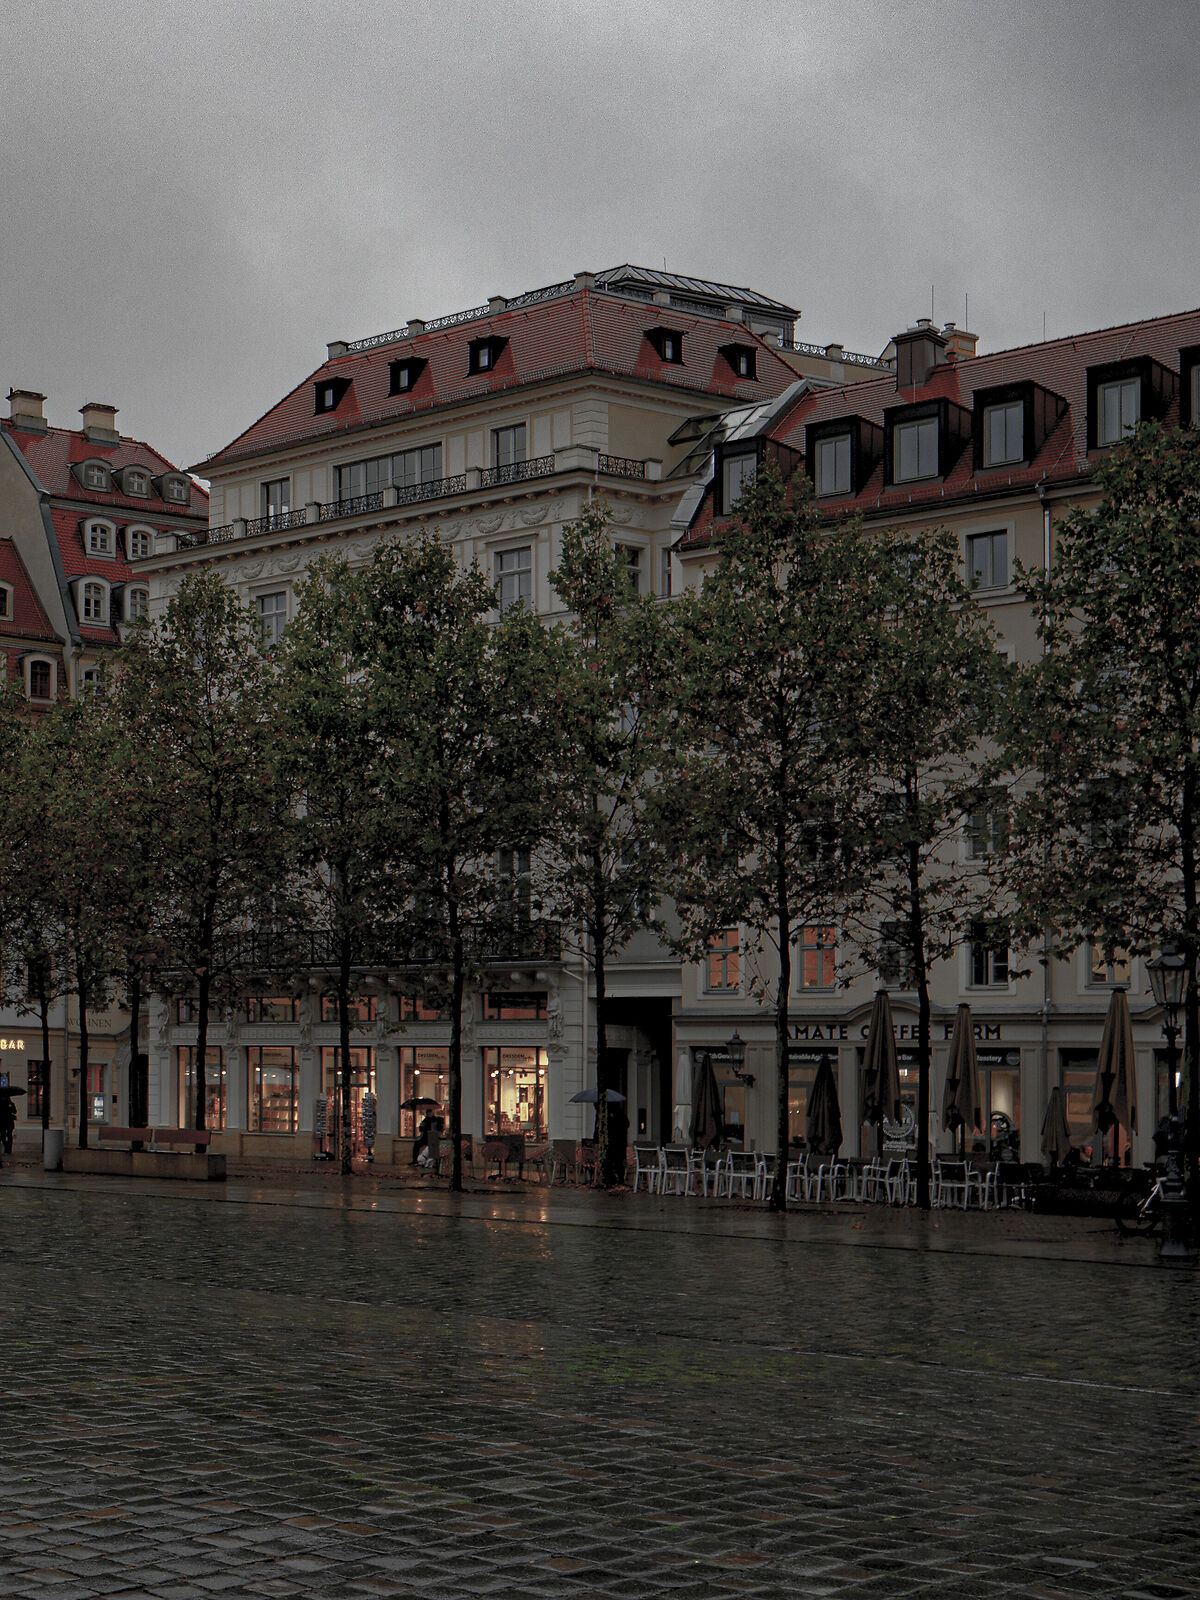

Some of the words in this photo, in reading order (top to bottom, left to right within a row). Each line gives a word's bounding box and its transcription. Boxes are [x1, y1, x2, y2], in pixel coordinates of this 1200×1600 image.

[67, 1017, 112, 1027] WONEN
[860, 1024, 931, 1040] CFFE
[944, 1024, 1001, 1040] FRM
[0, 1038, 25, 1050] BAR
